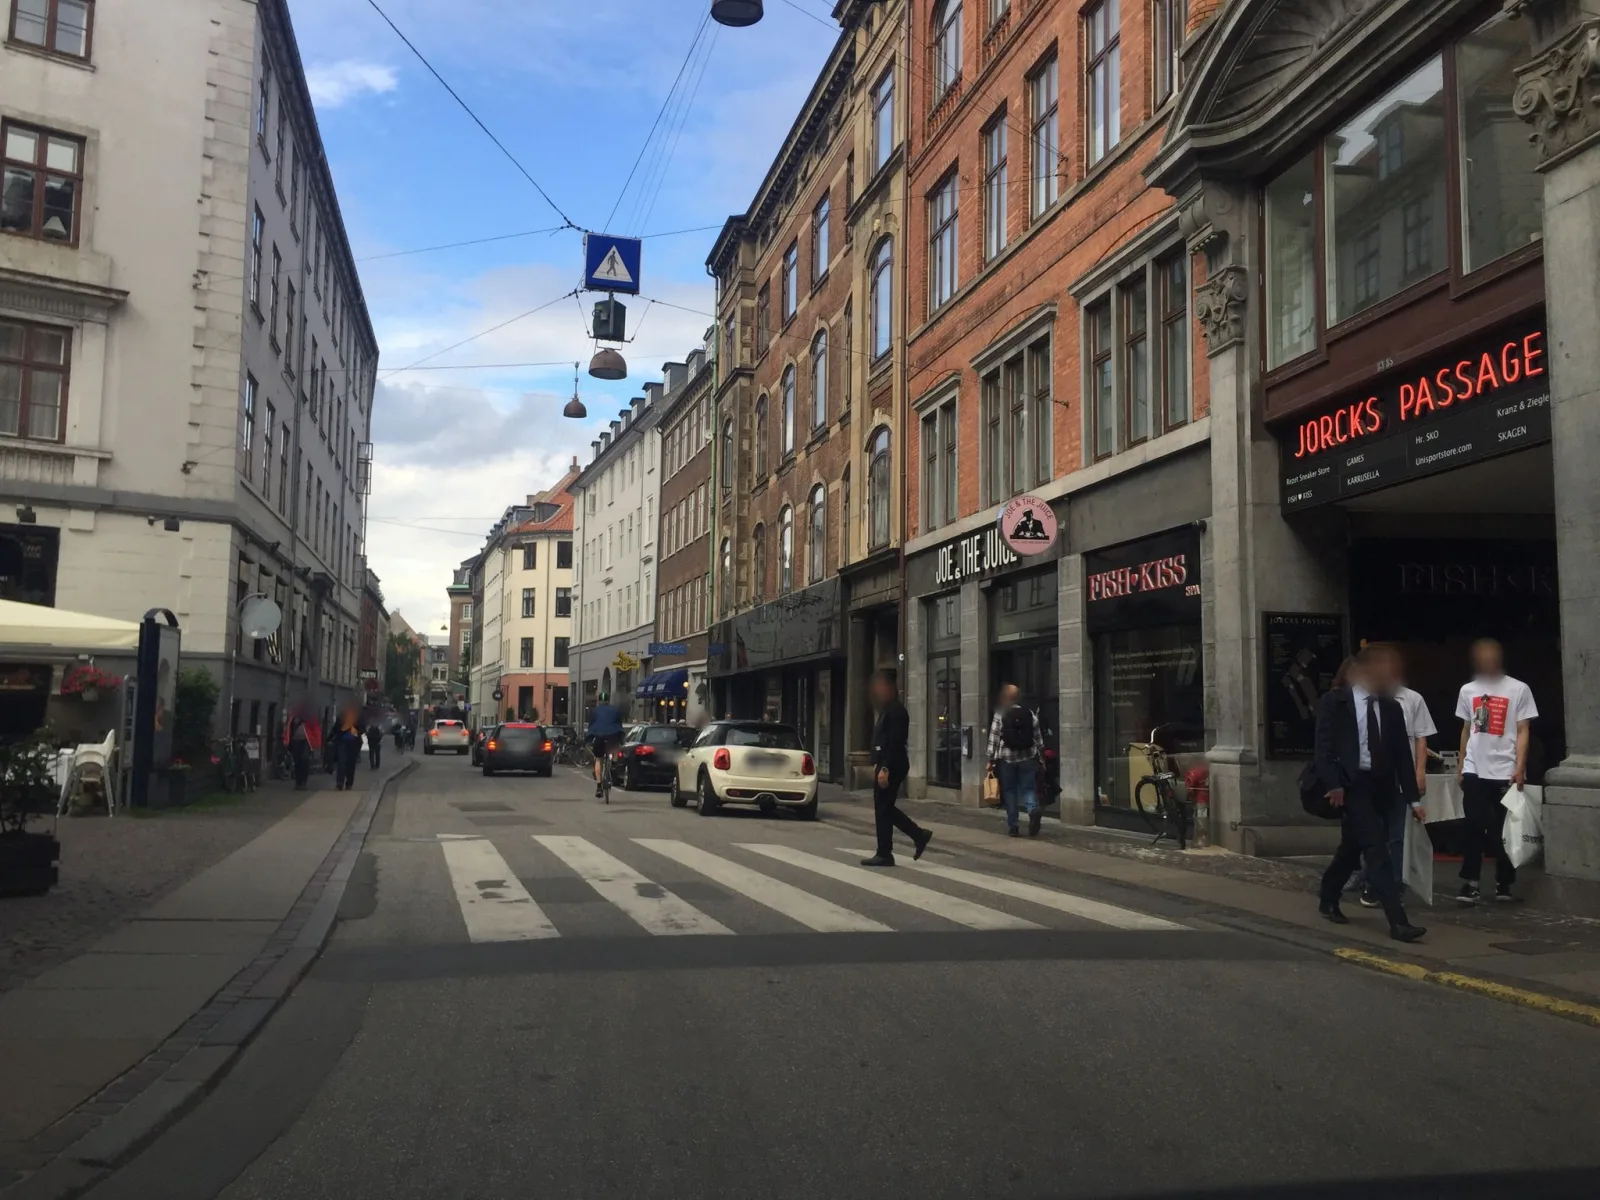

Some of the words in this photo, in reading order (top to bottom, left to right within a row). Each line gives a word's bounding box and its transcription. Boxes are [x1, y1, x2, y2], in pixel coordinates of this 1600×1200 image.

[1294, 397, 1381, 458] JORCKS
[1400, 331, 1545, 421] PASSAGE
[1496, 404, 1518, 417] Kranz
[1519, 400, 1526, 410] &
[1498, 425, 1527, 442] SKAGEN
[1346, 454, 1365, 467] GAMES
[1415, 442, 1473, 466] Unisportstore.com
[1299, 470, 1317, 482] Sneaker
[1317, 466, 1331, 476] Store
[1347, 469, 1380, 486] KARRUSELLA
[1287, 494, 1298, 504] FISH
[1302, 490, 1313, 500] KISS
[1004, 504, 1016, 519] JOE
[1022, 498, 1036, 506] THE
[1036, 502, 1054, 520] JUICE
[935, 544, 954, 584] JOE
[954, 567, 962, 579] &
[961, 534, 980, 577] THE
[1088, 566, 1132, 602] FISH
[1139, 554, 1187, 592] KISS
